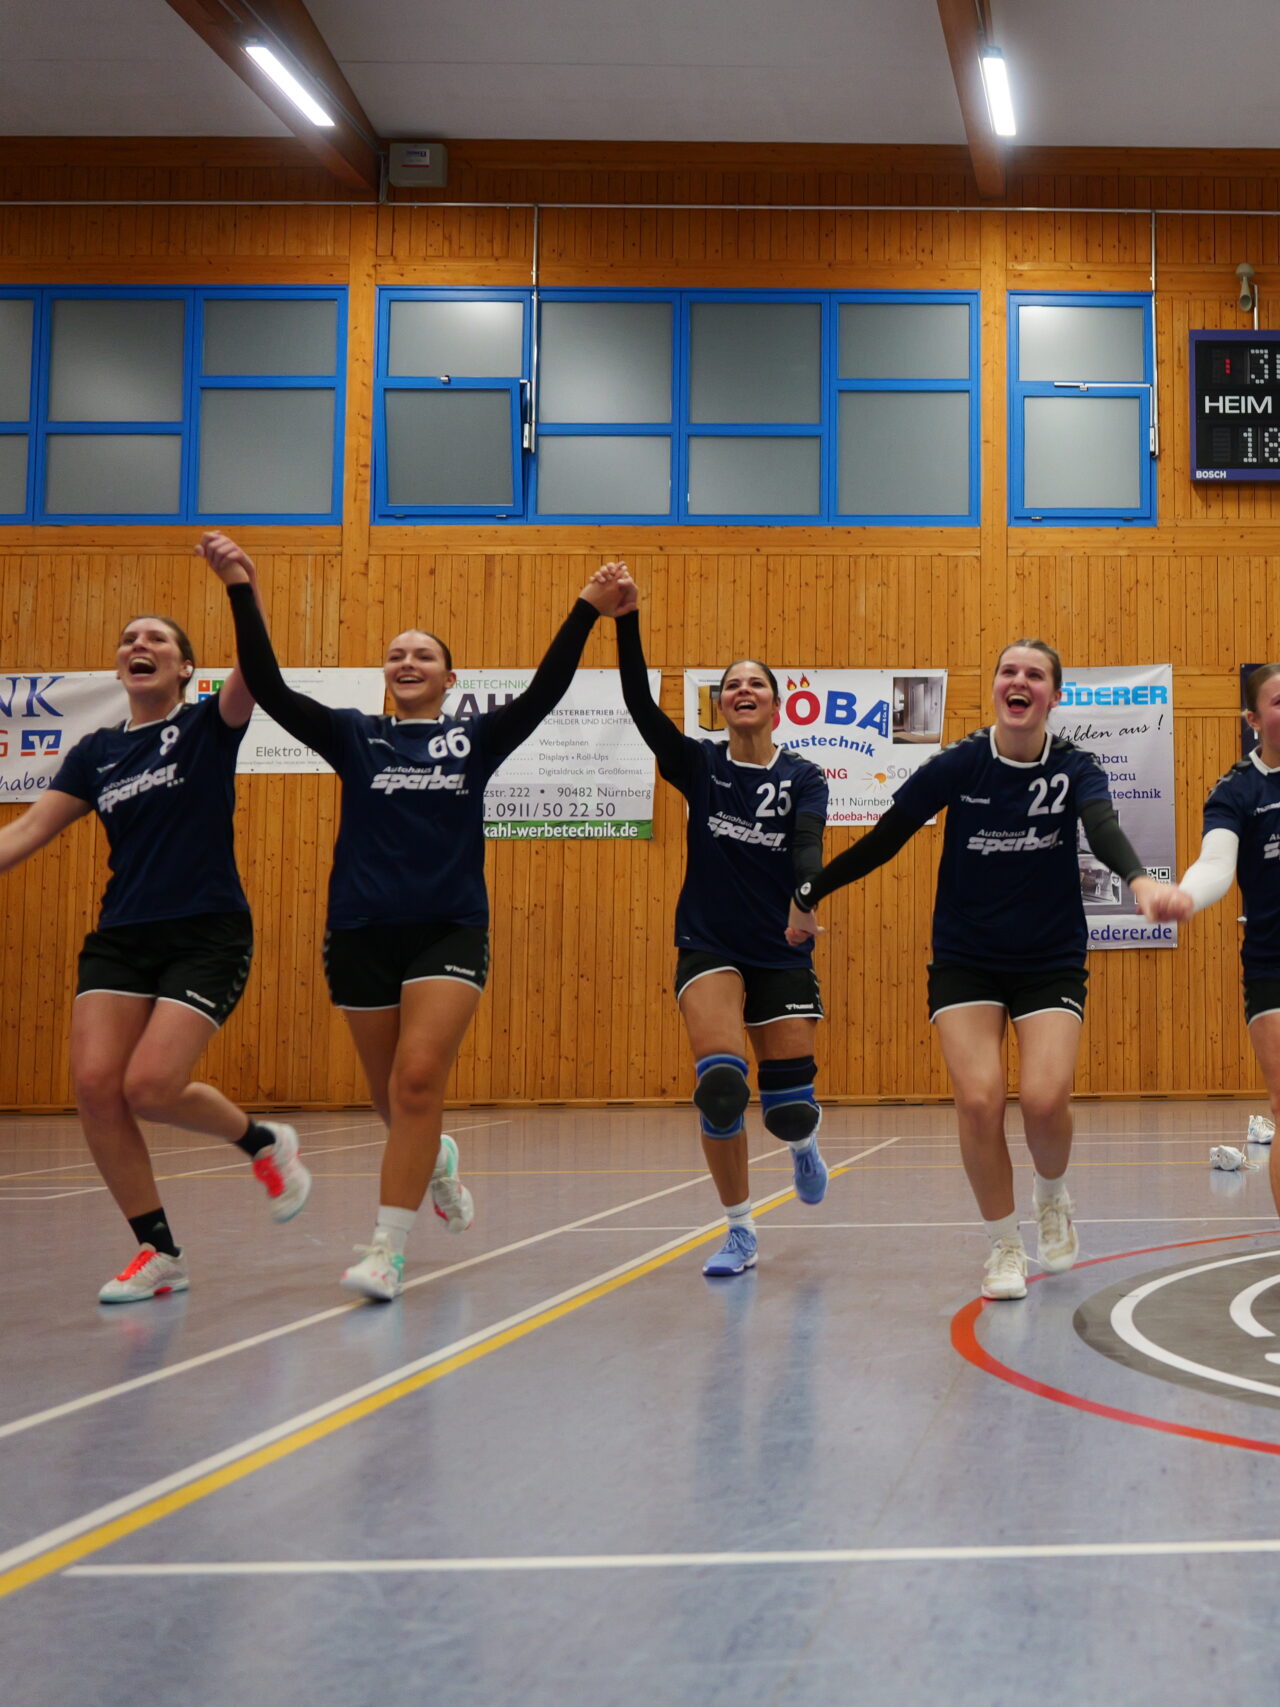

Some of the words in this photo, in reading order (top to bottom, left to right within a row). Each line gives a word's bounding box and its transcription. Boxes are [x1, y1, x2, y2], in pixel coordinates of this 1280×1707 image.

[1204, 395, 1273, 414] HEIM
[1195, 470, 1227, 479] BOSCH
[453, 680, 528, 690] RBETECHNIK
[1058, 682, 1168, 706] ÖDERER
[1118, 723, 1151, 736] aus
[160, 724, 180, 756] 8
[428, 727, 471, 759] 66
[539, 739, 589, 748] Werbeplanen
[780, 735, 876, 757] austechnik
[256, 746, 302, 757] Elektro
[538, 753, 569, 763] Displays
[576, 753, 609, 763] Roll-Ups
[382, 766, 432, 774] Autohaus
[538, 767, 583, 777] Digitaldruck
[597, 767, 643, 776] Großformat
[484, 788, 507, 798] zstr.
[510, 787, 530, 798] 222
[557, 787, 592, 798] 90482
[597, 787, 651, 800] Nürnberg
[755, 780, 792, 817] 25
[1027, 773, 1070, 817] 22
[1112, 788, 1162, 799] technik
[828, 798, 845, 806] 411
[568, 803, 593, 818] 22
[595, 803, 616, 818] 50
[483, 822, 638, 838] kahl-werbetechnik.de
[977, 829, 1026, 838] Autohaus
[1090, 924, 1173, 942] ederer.de
